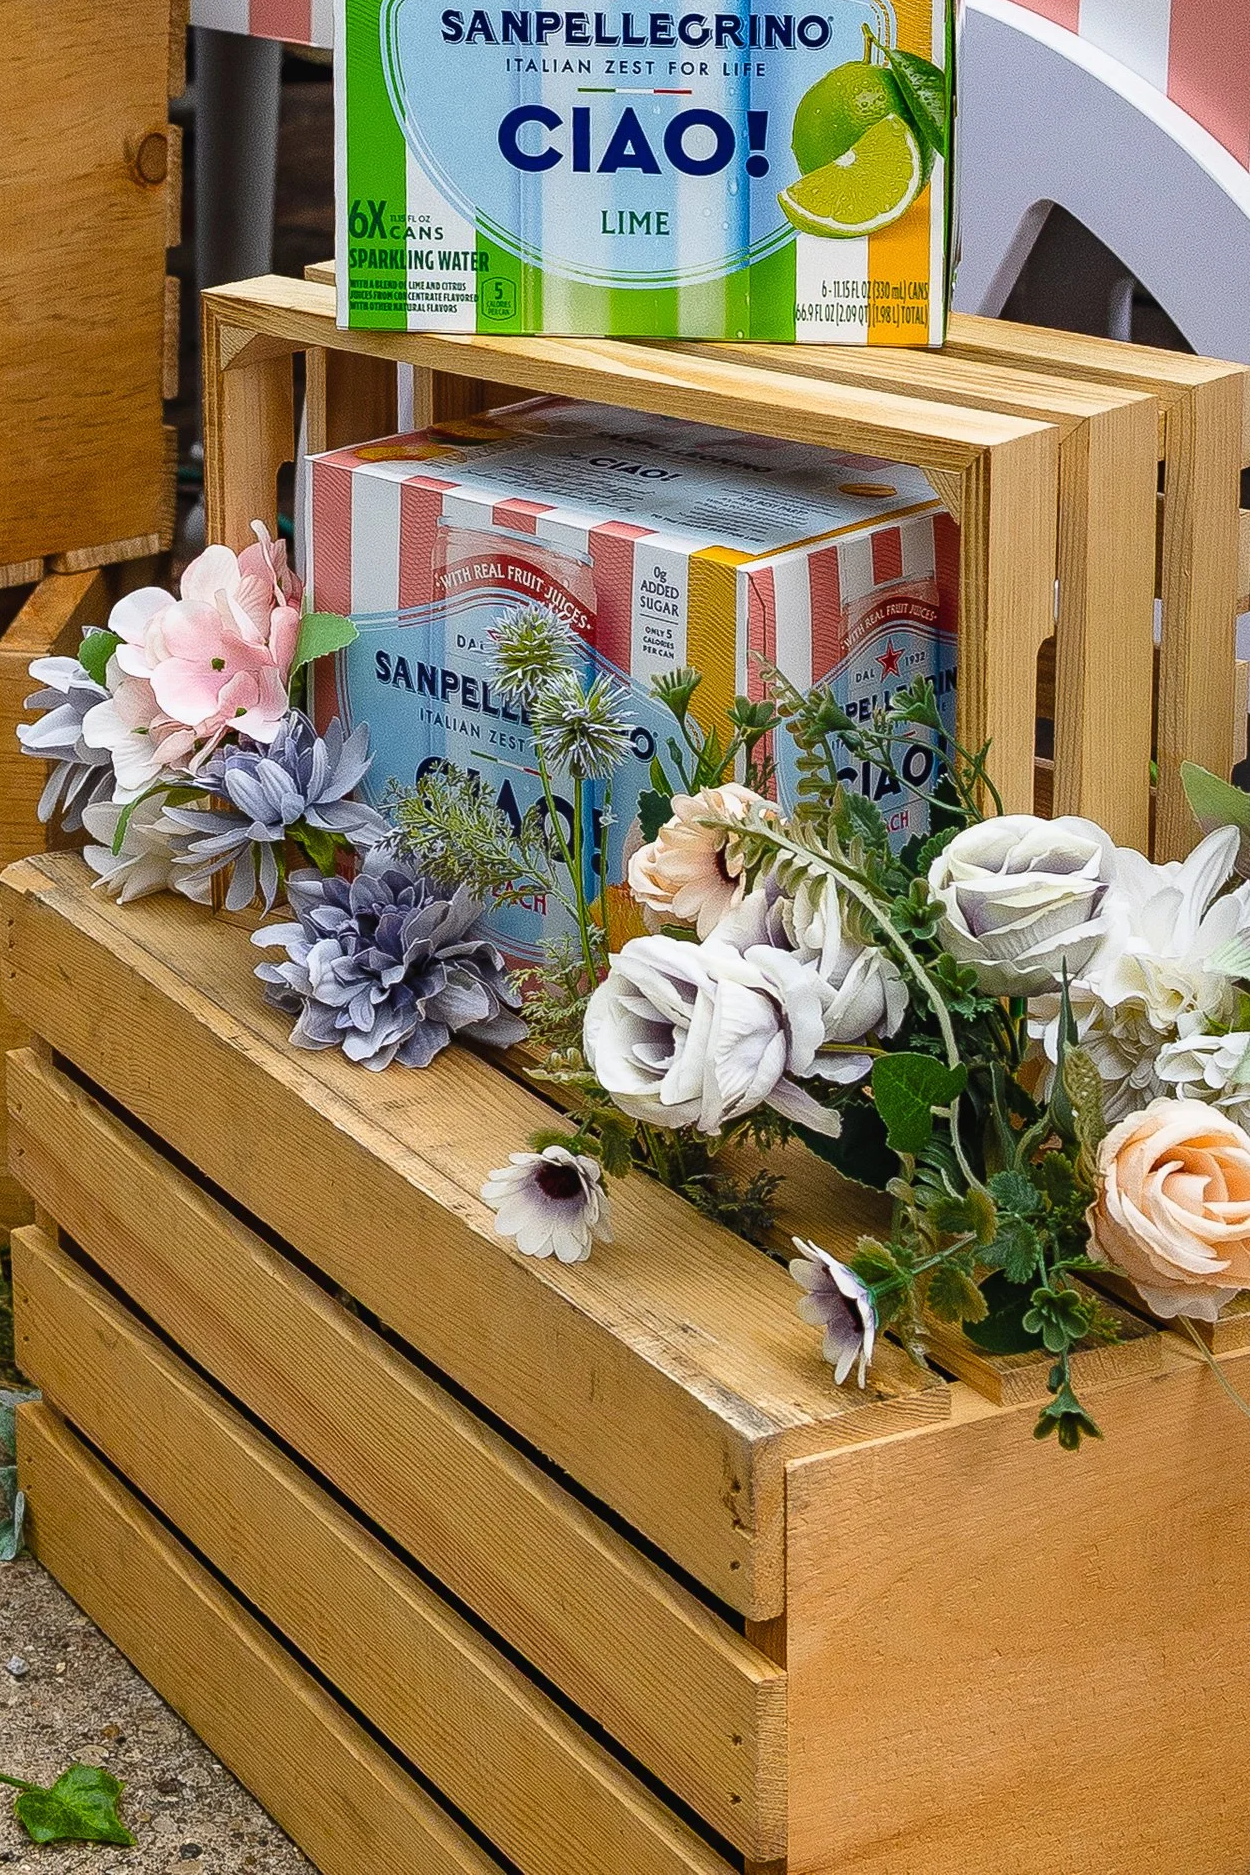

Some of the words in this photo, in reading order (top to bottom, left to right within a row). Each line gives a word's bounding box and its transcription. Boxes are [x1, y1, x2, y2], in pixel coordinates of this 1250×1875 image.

[506, 58, 592, 74] ITALIAN
[605, 59, 655, 75] ZEST
[668, 61, 710, 76] FOR
[723, 62, 766, 77] LIFE
[497, 103, 771, 179] CIAO!
[349, 199, 388, 240] 6X
[408, 215, 417, 223] FL
[418, 215, 431, 223] OZ
[601, 210, 671, 236] LIME
[390, 226, 444, 241] CANS
[349, 247, 434, 270] SPARKLING
[438, 250, 490, 272] WATER
[408, 281, 425, 290] LIME
[426, 281, 441, 290] AND
[442, 281, 466, 291] CITRUS
[494, 281, 503, 300] 5
[851, 280, 860, 299] FL
[861, 281, 871, 299] OZ
[908, 280, 929, 300] CANS
[444, 293, 479, 303] FLAVORED
[426, 303, 458, 314] FLAVORS
[795, 303, 813, 322] 66.9
[815, 303, 823, 322] FL
[824, 304, 835, 322] OZ
[588, 456, 683, 482] CIAO!
[653, 566, 668, 583] 0g
[440, 565, 470, 589] WITH
[474, 563, 505, 583] REAL
[507, 566, 544, 593] FRUIT
[544, 584, 588, 629] JUICES
[640, 580, 679, 600] ADDED
[640, 595, 680, 617] SUGAR
[865, 609, 886, 627] REAL
[886, 603, 908, 617] FRUIT
[643, 635, 675, 650] CALORIES
[644, 626, 665, 638] ONLY
[666, 629, 673, 639] 5
[856, 668, 875, 683] DAL
[905, 651, 926, 667] 1932
[420, 708, 481, 739] ITALIAN
[489, 729, 526, 753] ZEST
